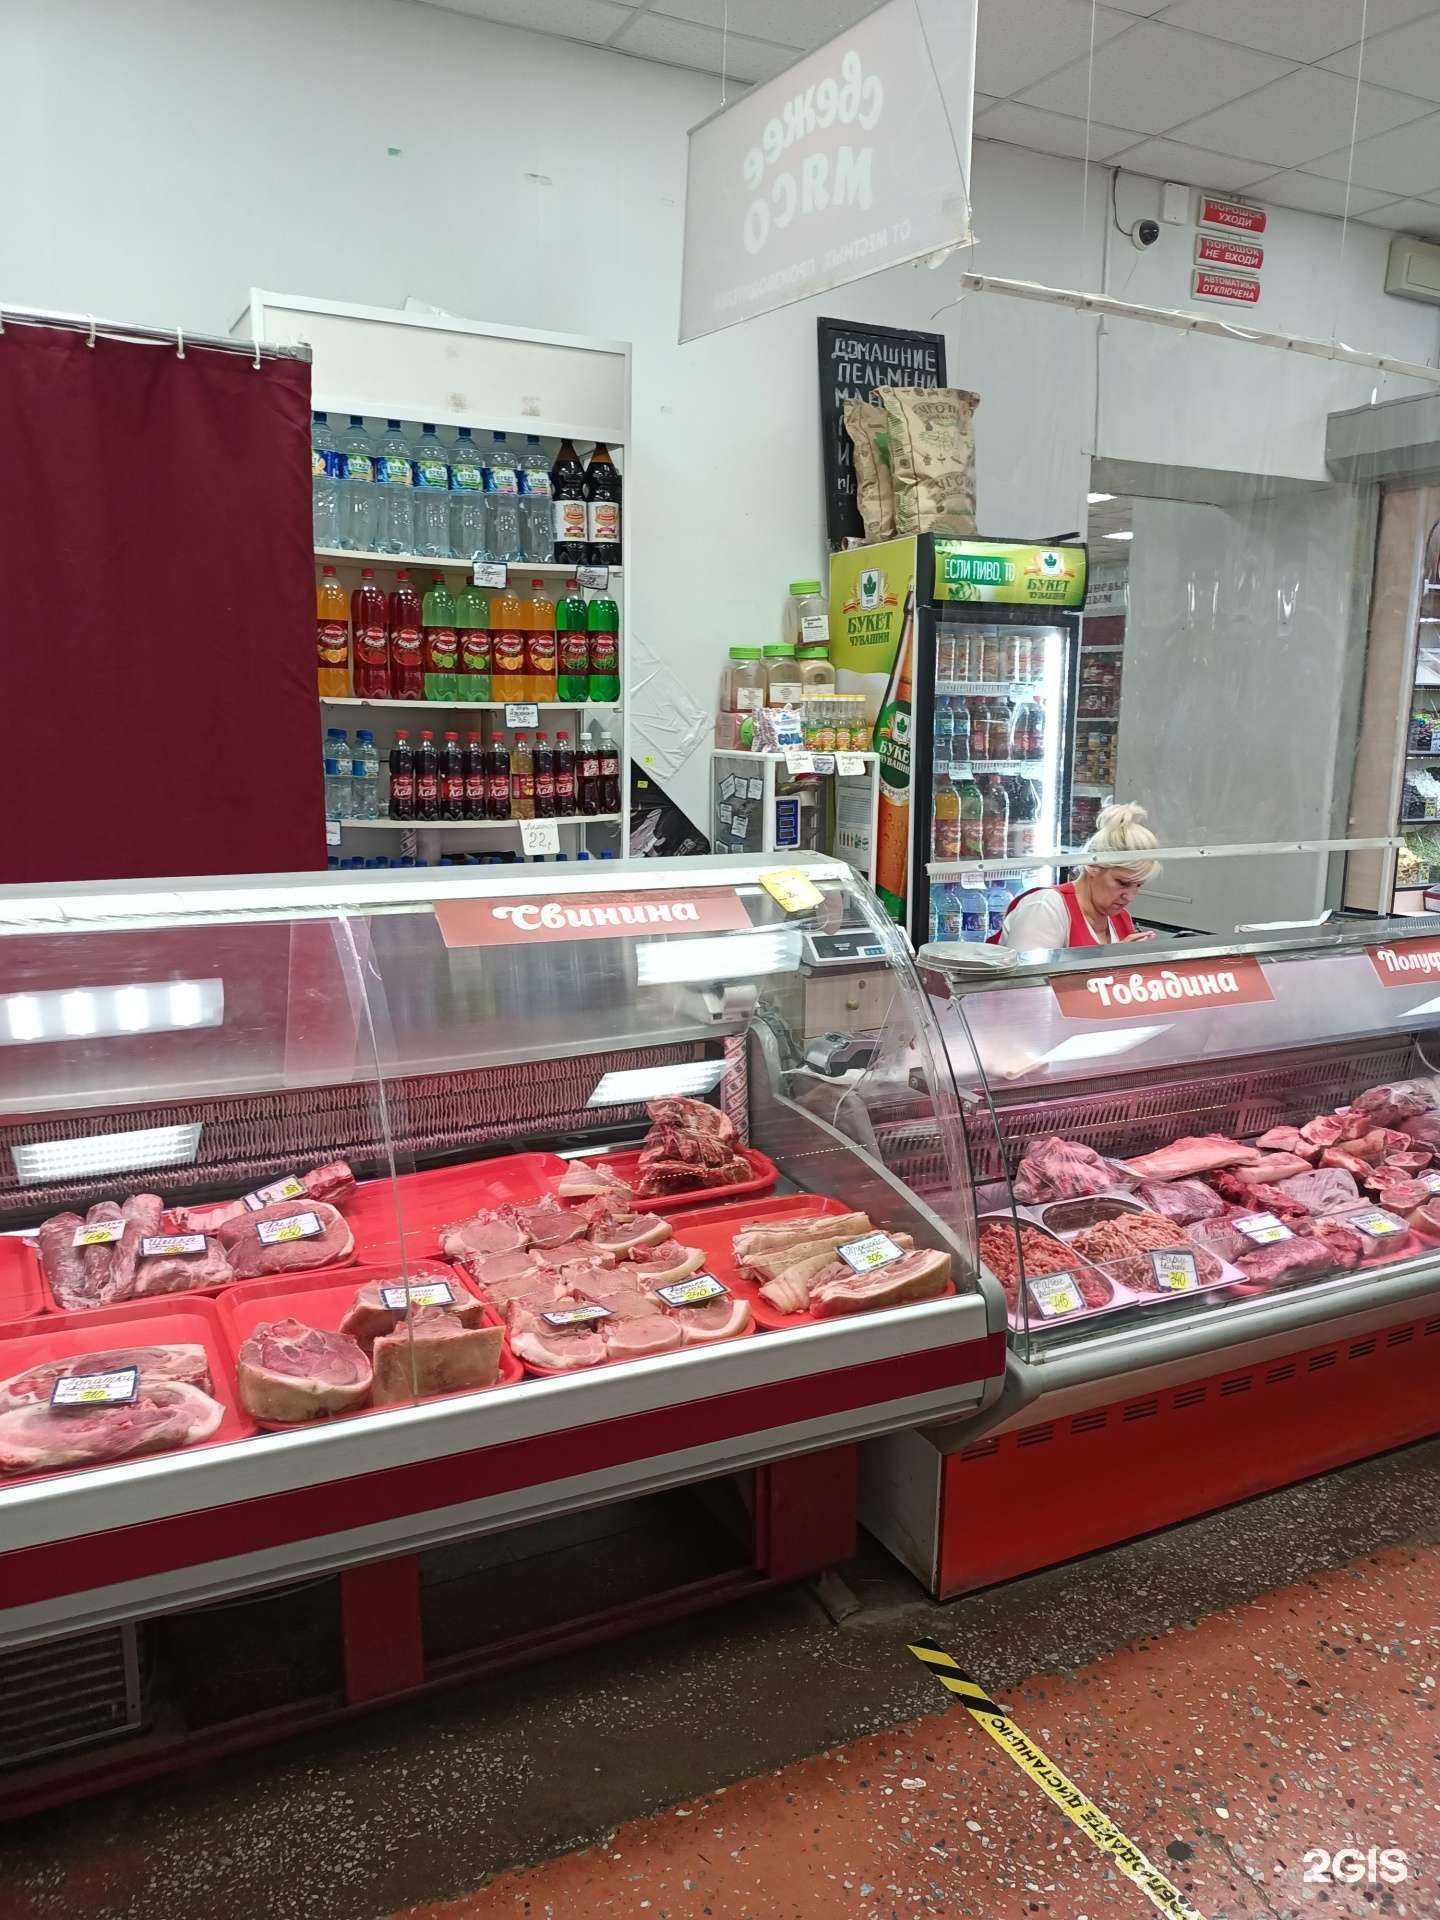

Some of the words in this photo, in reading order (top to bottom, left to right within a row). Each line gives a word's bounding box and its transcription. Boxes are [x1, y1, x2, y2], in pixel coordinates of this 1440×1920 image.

[1219, 212, 1252, 226] УХОДИ
[1205, 248, 1220, 258] НЕ
[1225, 252, 1259, 265] ВХОДИ
[1206, 239, 1260, 256] ПОРОШОК
[1202, 284, 1255, 299] ОТКЛЮЧЕНА
[1204, 275, 1255, 290] АВТОМАТИКА
[831, 338, 937, 371] ДОМАШНИЕ
[838, 363, 939, 388] ПЕЛЬМЕНИ
[944, 558, 970, 579] ЕСЛИ
[973, 560, 1002, 582] ПИВО,
[1004, 562, 1016, 582] ТО
[1027, 578, 1070, 593] БУКЕТ
[848, 611, 893, 634] БУКЕТ
[492, 901, 700, 930] Свинина
[1087, 970, 1239, 1006] Говядина
[991, 1717, 1084, 1809] ДИСТАНЦИЮ
